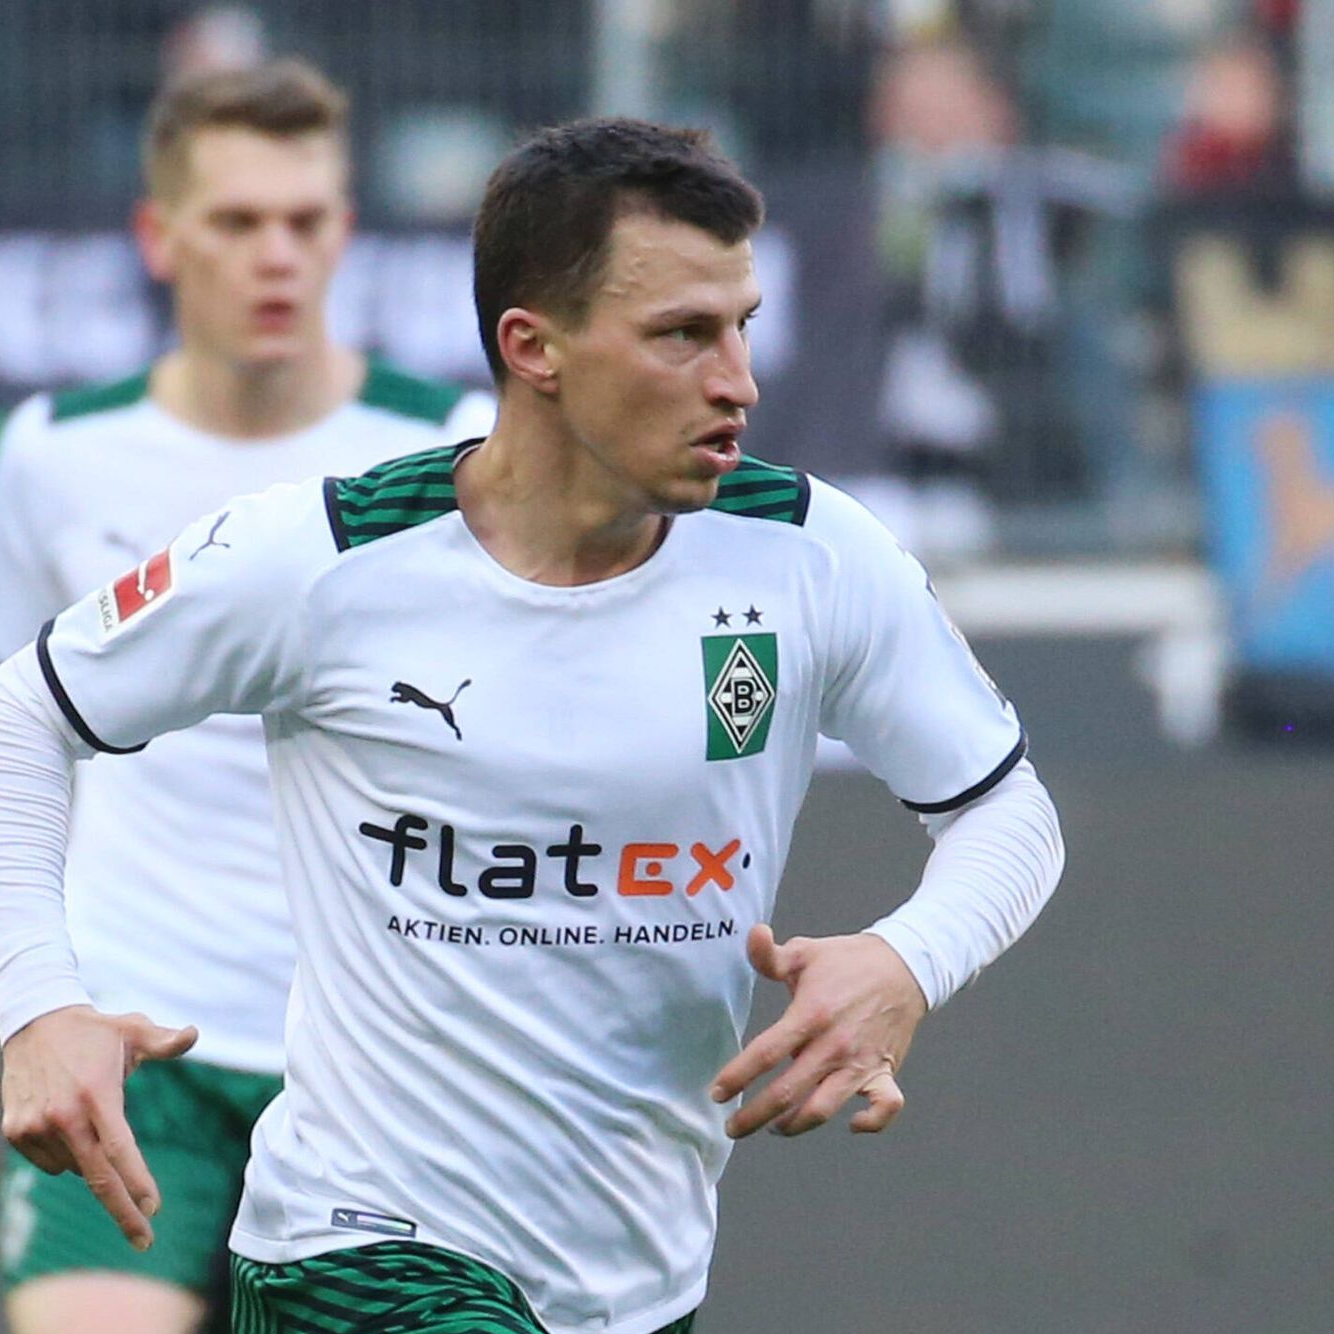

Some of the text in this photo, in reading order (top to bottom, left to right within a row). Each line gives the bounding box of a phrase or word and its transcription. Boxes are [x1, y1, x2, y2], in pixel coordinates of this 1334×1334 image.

[732, 678, 756, 716] B
[386, 915, 738, 946] AKTIEN. ONLINE. HANDELN.
